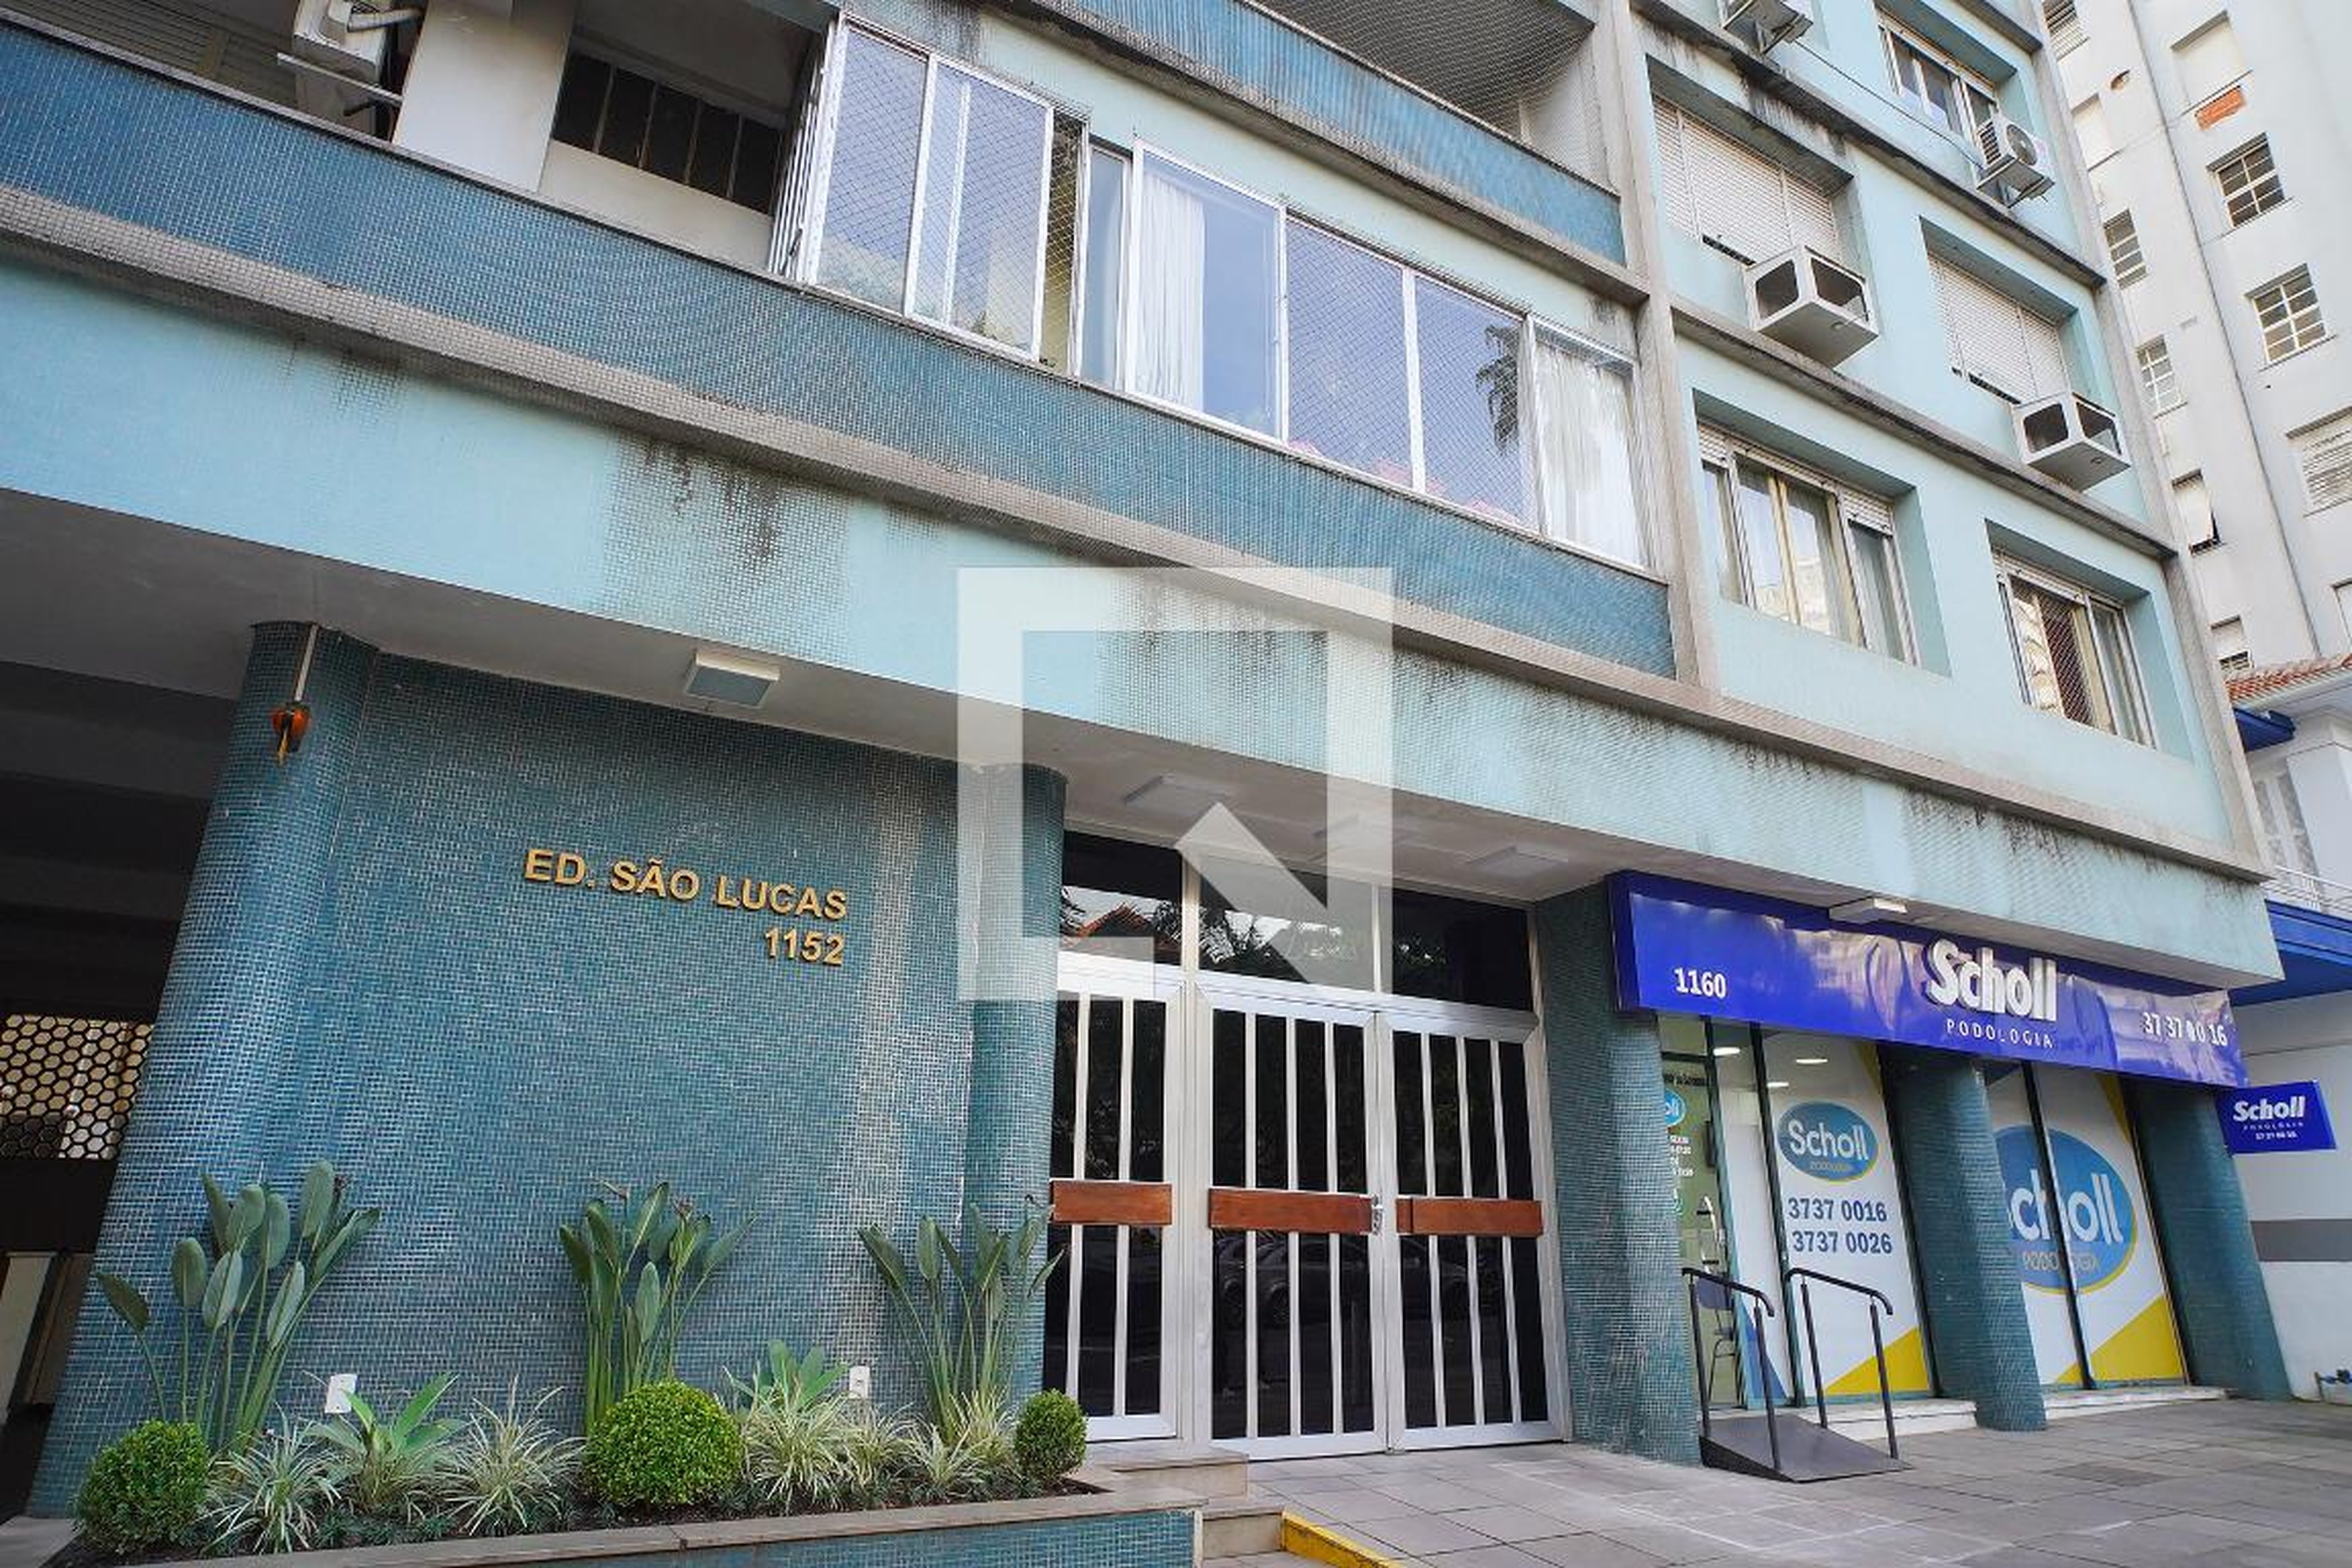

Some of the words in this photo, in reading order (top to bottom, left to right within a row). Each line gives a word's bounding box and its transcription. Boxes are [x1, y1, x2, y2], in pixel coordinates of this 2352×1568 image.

[524, 848, 595, 887] ED.
[611, 858, 700, 901] SÃO
[715, 876, 847, 919] LUCAS
[764, 927, 845, 967] 1152
[1674, 967, 1727, 998] 1160
[1926, 939, 2056, 1022] Scholl
[1946, 1018, 2053, 1049] PODOLOGIA
[2233, 1096, 2305, 1122] Scholl
[1788, 1119, 1868, 1161] Scholl
[1788, 1197, 1834, 1220] 3737
[1841, 1200, 1887, 1222] 0016
[2007, 1168, 2124, 1245] choll
[1792, 1231, 1839, 1253] 3737
[1845, 1232, 1892, 1254] 0026
